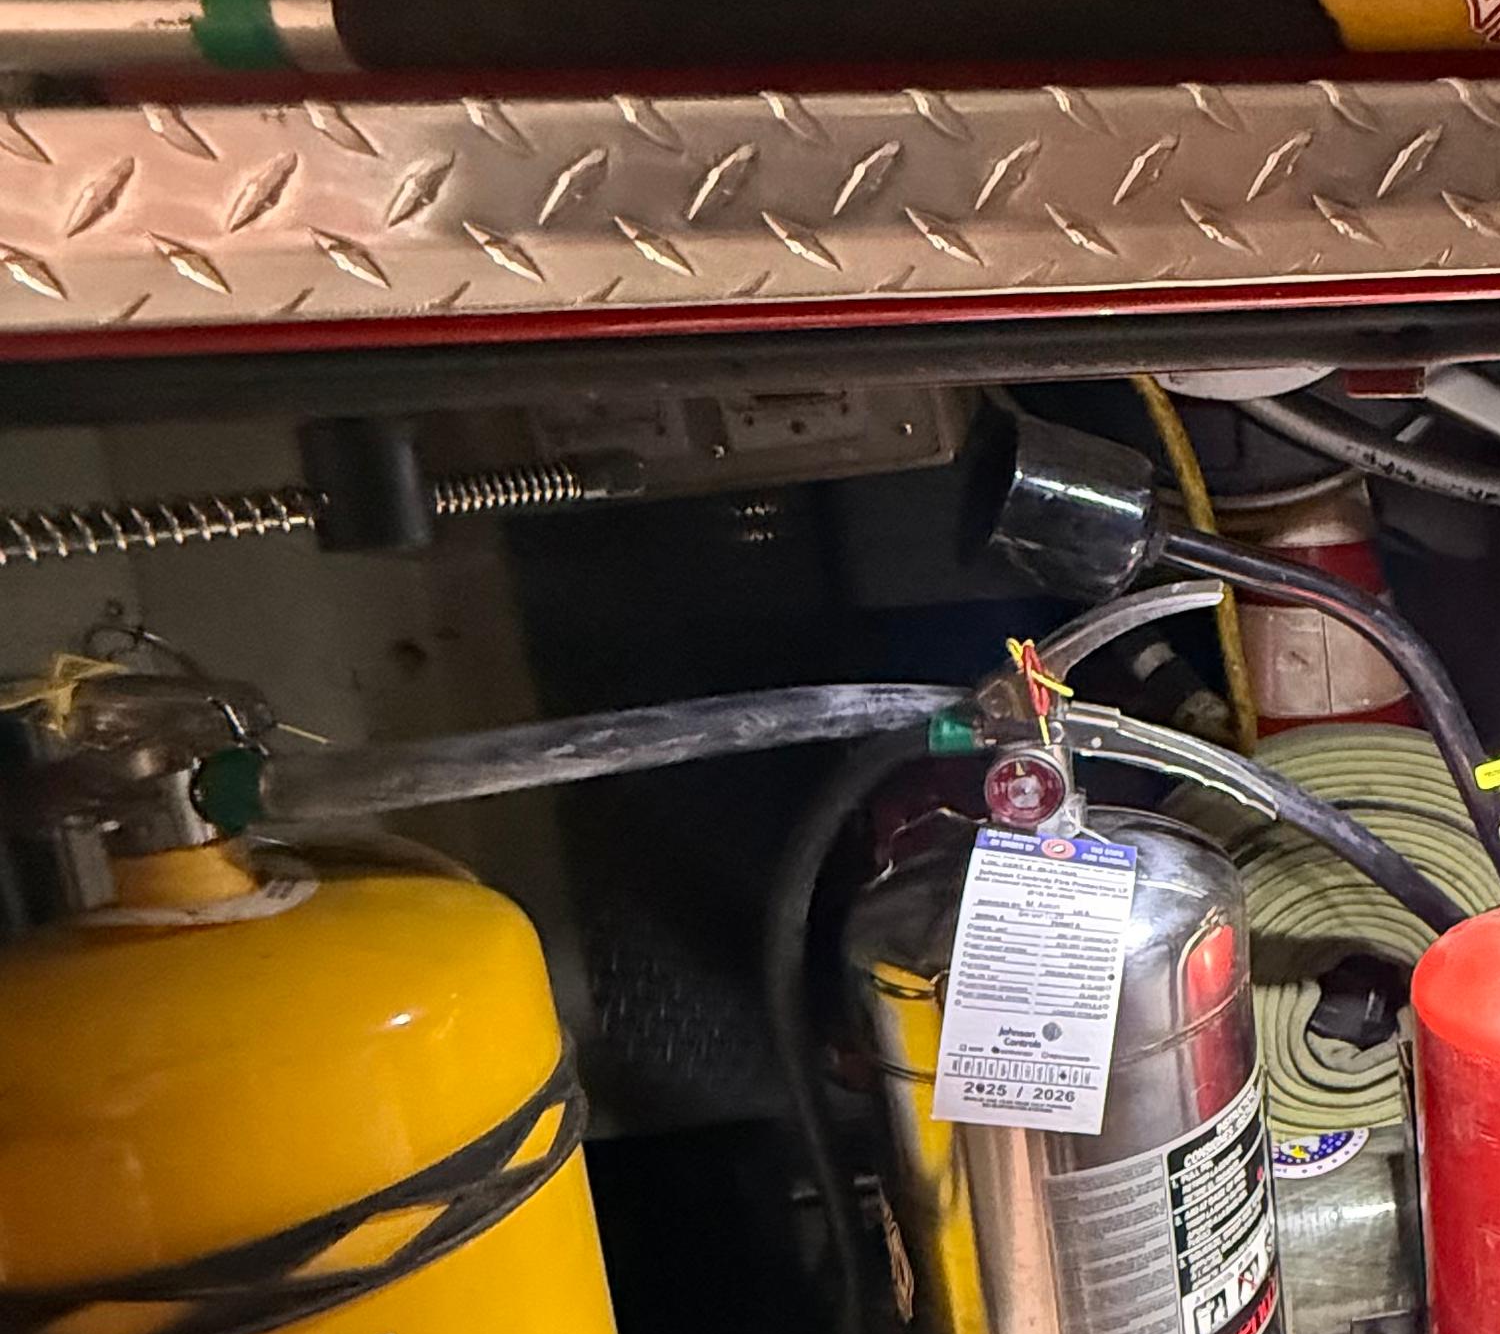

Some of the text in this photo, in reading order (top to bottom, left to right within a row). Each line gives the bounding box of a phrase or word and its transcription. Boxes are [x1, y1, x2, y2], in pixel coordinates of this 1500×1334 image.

[998, 1026, 1036, 1038] Johnson
[1004, 1037, 1042, 1048] Controls
[964, 1081, 1007, 1097] 225
[1033, 1087, 1075, 1103] 2026
